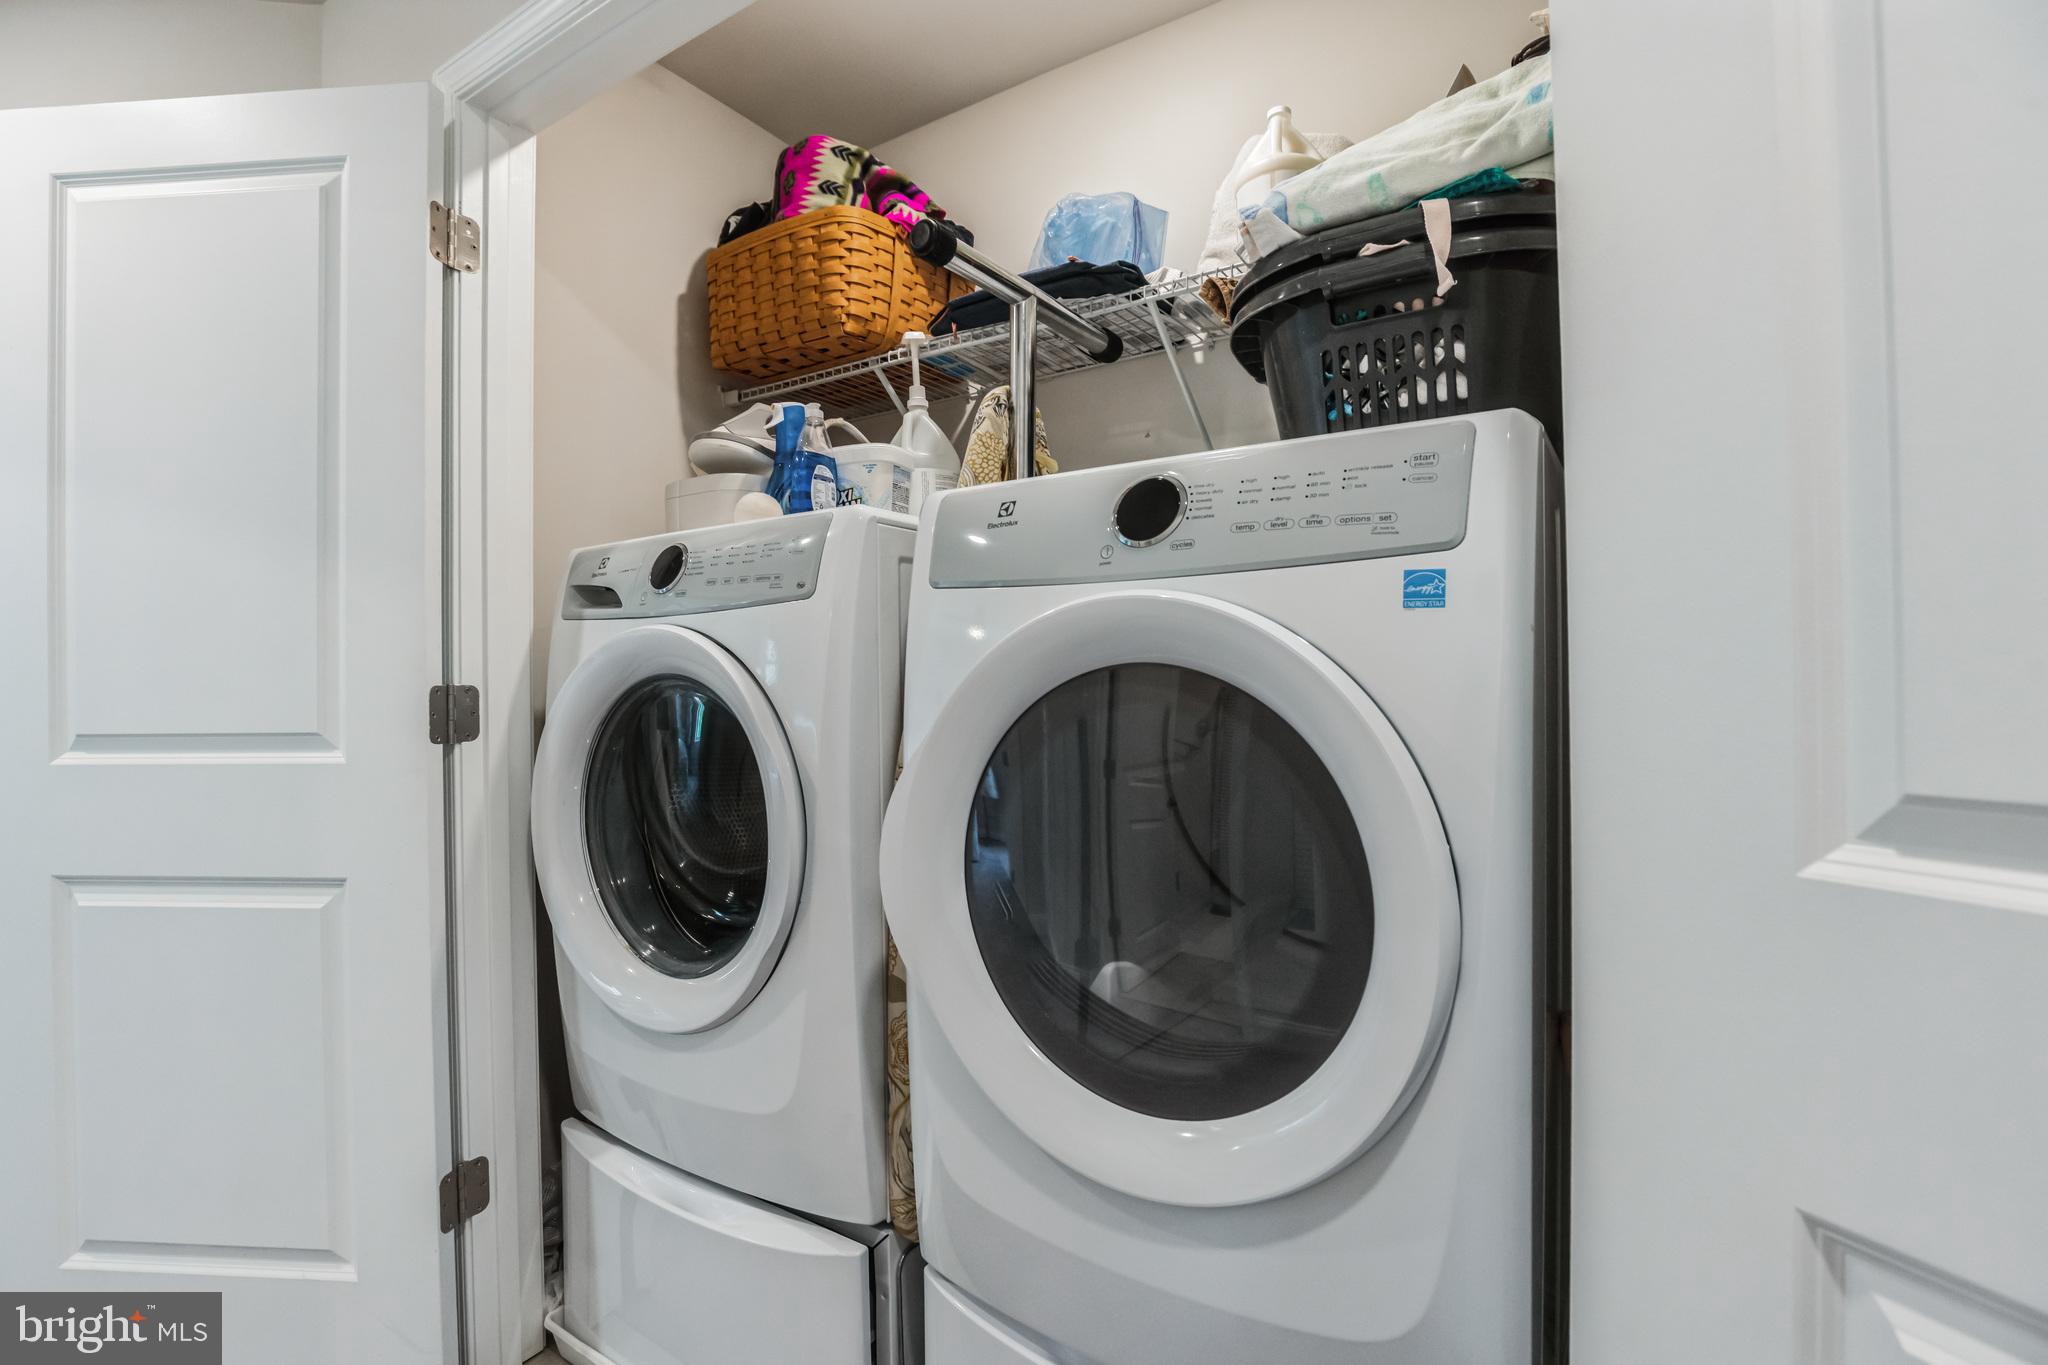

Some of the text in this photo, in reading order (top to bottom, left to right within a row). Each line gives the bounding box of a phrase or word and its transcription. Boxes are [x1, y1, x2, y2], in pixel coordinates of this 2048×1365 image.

[1413, 453, 1436, 462] start
[1305, 518, 1323, 526] time
[1339, 514, 1392, 525] options set
[987, 520, 1018, 530] Electrolux
[1235, 522, 1256, 532] temp
[1270, 521, 1288, 529] level
[1404, 600, 1445, 608] ENERGY STAR
